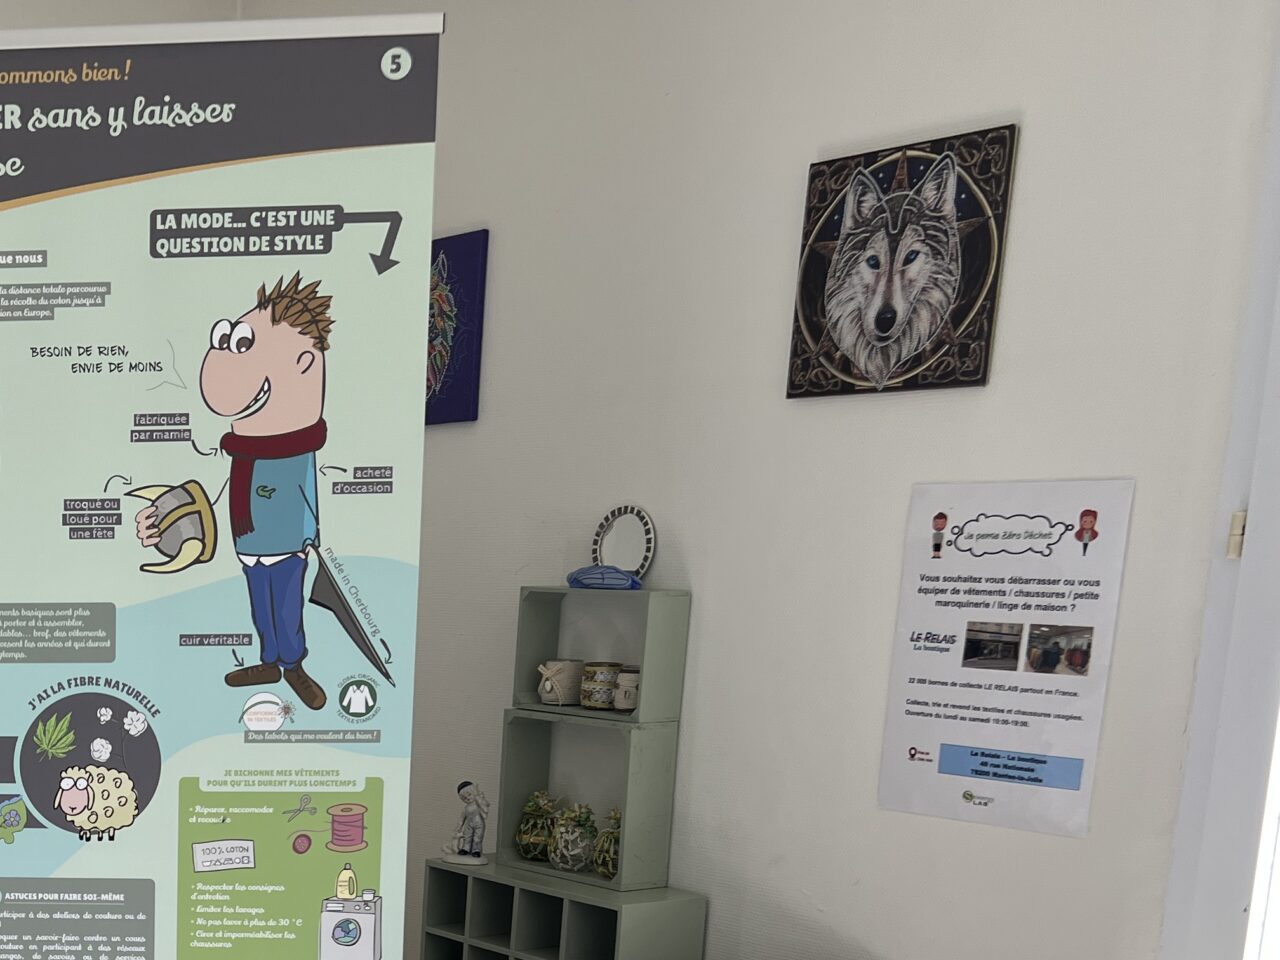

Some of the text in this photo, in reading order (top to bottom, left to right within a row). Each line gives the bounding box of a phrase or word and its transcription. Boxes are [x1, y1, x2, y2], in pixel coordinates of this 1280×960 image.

[389, 54, 402, 73] 5
[81, 62, 119, 82] bien
[28, 106, 102, 130] sans
[107, 110, 127, 136] y
[133, 95, 236, 126] laisser
[156, 210, 335, 229] LA MODE... C'EST UNE
[156, 234, 324, 257] QUESTION DE STYLE
[16, 253, 43, 264] nous
[0, 285, 7, 294] la
[30, 345, 129, 358] BESOIN DE RIEN,
[71, 361, 163, 374] ENVIE DE MOINS
[135, 414, 188, 426] fabriquée
[132, 429, 191, 441] par mamie
[356, 467, 392, 478] acheté
[334, 482, 391, 493] d'occasion
[66, 499, 118, 511] troqué ou
[66, 514, 118, 526] loué pour
[71, 527, 113, 539] une fête
[919, 574, 1100, 587] Vous souhaitez vous débarrasser ou vous
[323, 546, 381, 638] made in Cherbourg
[917, 586, 948, 596] équiper
[950, 587, 960, 595] de
[962, 586, 1007, 597] vêtements
[1014, 589, 1066, 599] chaussures
[1073, 590, 1099, 600] petite
[935, 599, 991, 610] maroquinerie
[997, 601, 1018, 612] linge
[1021, 602, 1032, 611] de
[1034, 602, 1068, 612] maison
[181, 635, 250, 645] cuir véritable
[910, 631, 956, 644] LE RELAIS
[28, 677, 161, 718] J'AI LA FIBRE NATURELLE
[5, 892, 124, 902] ASTUCES POUR FAIRE SOI-MÊME
